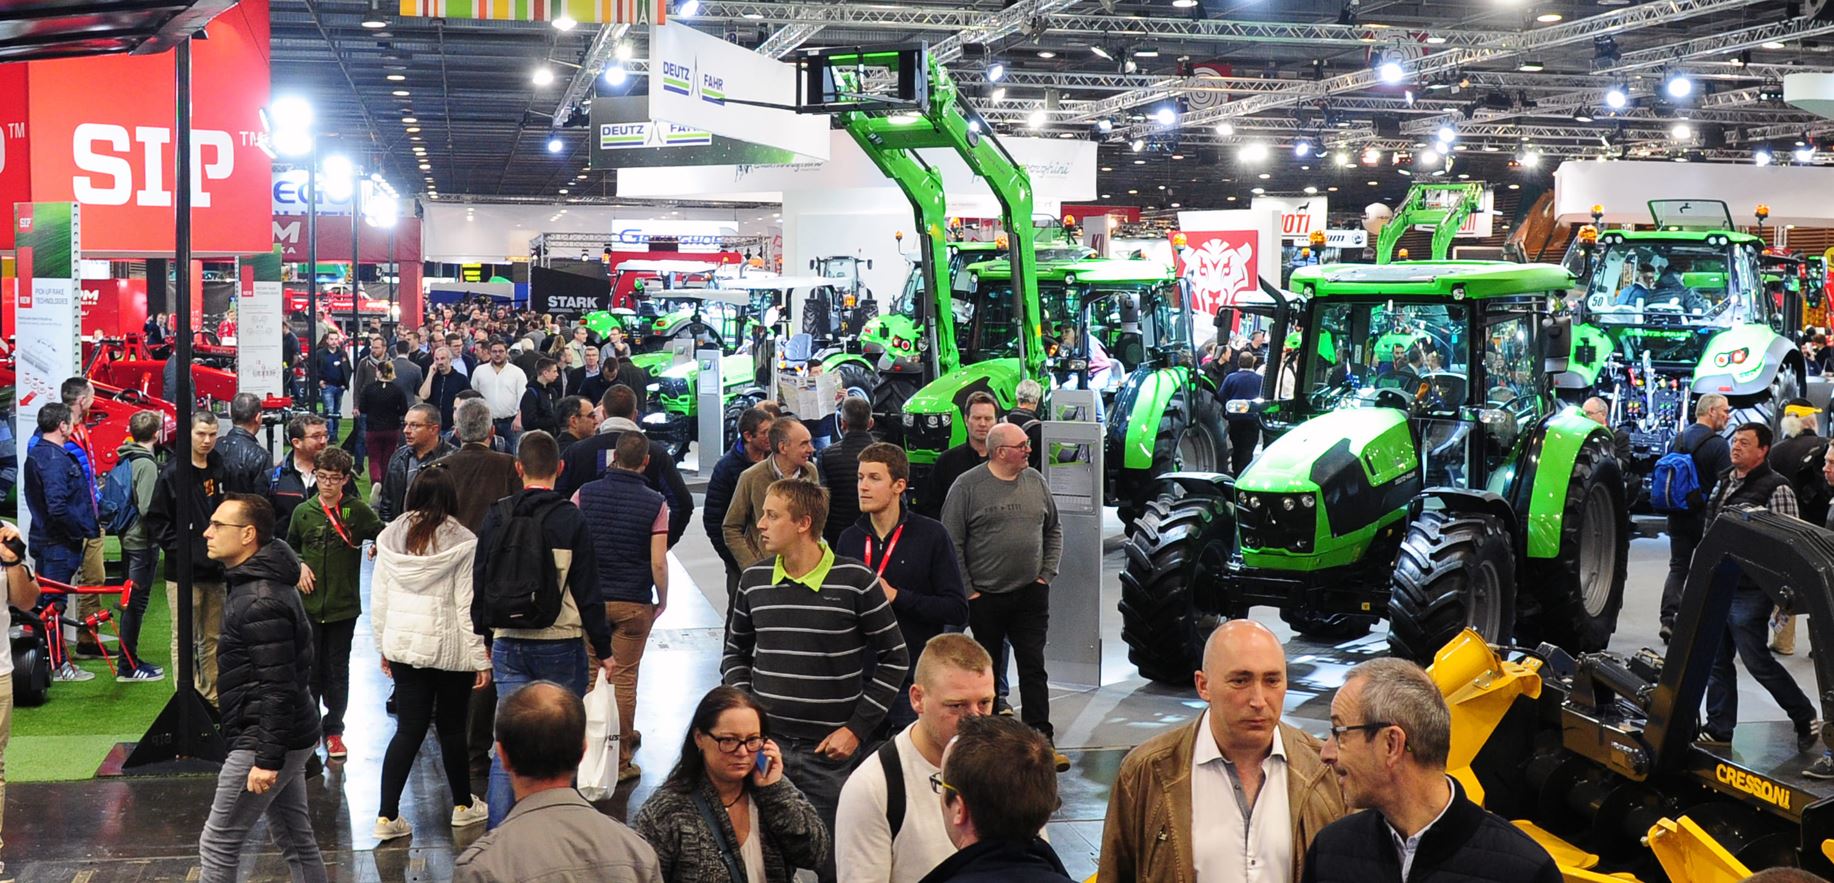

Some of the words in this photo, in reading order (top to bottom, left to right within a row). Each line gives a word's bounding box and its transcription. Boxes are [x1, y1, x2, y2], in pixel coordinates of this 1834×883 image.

[663, 61, 690, 81] DEUTZ
[704, 73, 724, 91] FAHR
[602, 125, 645, 135] DEUTZ
[72, 122, 234, 207] SIP
[547, 295, 599, 309] STARK
[1591, 295, 1604, 307] 50
